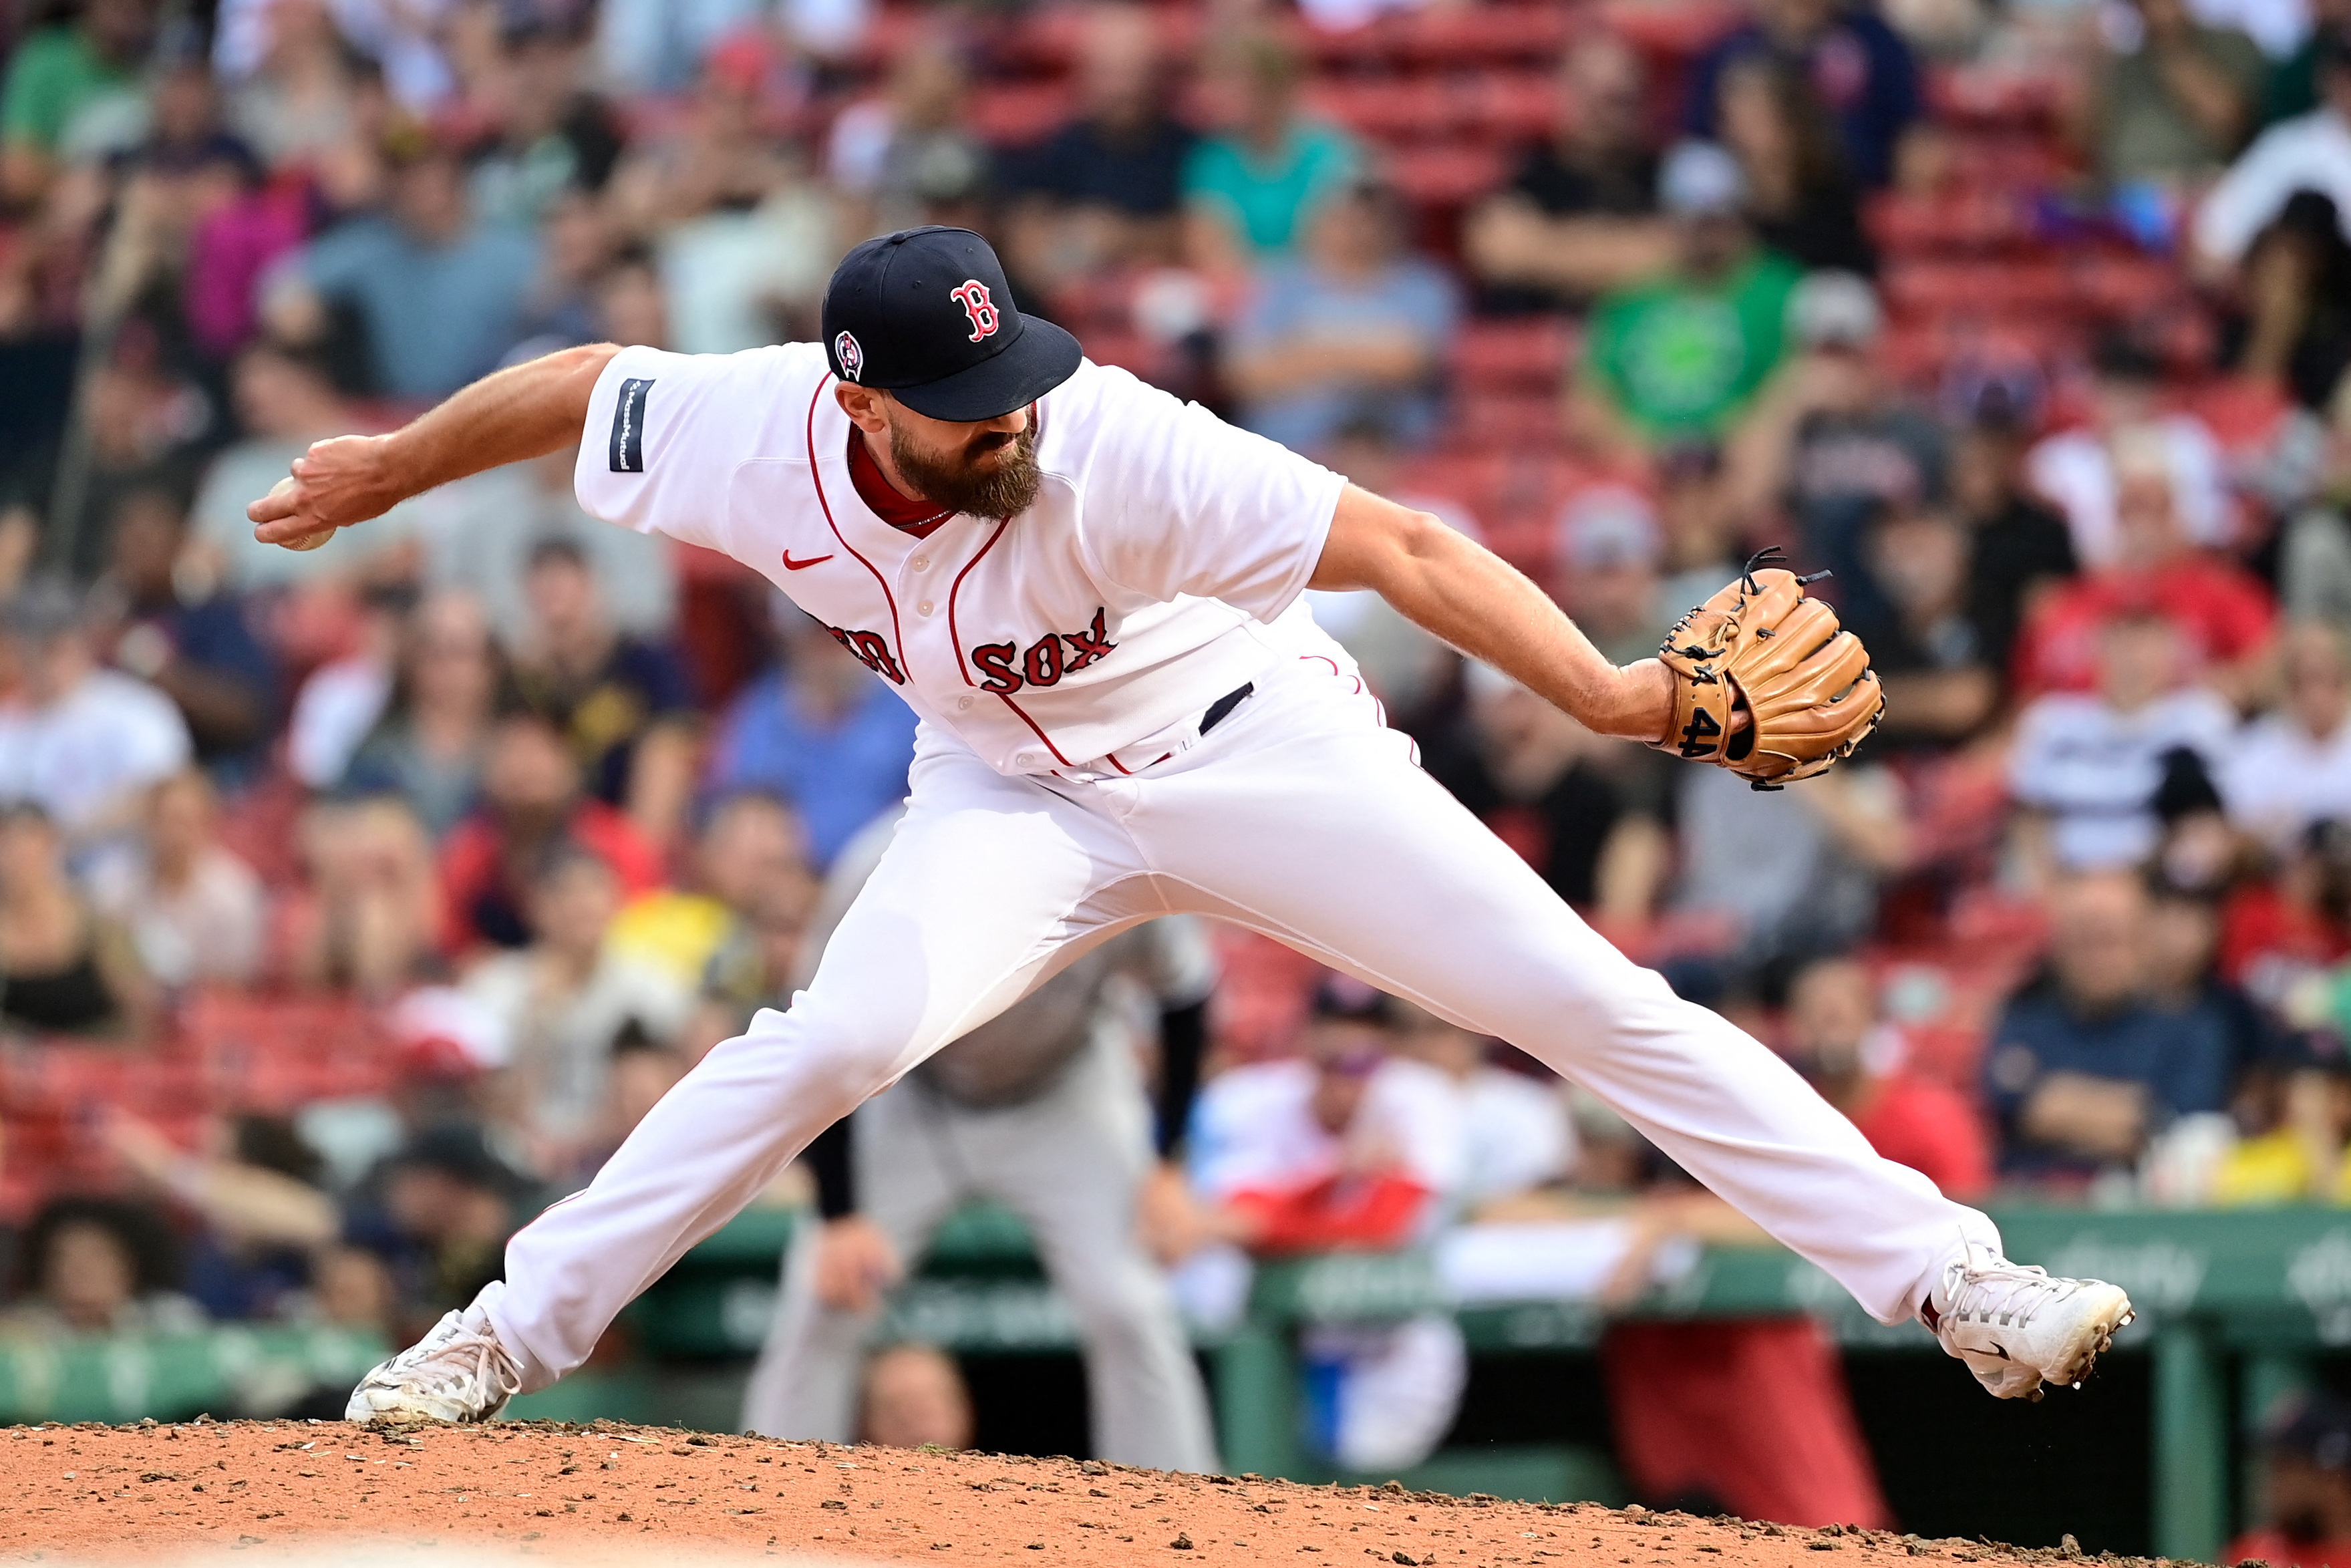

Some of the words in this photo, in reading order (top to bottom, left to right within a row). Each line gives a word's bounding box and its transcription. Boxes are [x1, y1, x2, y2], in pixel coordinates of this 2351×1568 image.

[950, 279, 999, 343] B
[619, 390, 635, 470] MassMutual
[971, 607, 1119, 695] SOX
[1677, 707, 1722, 758] 44
